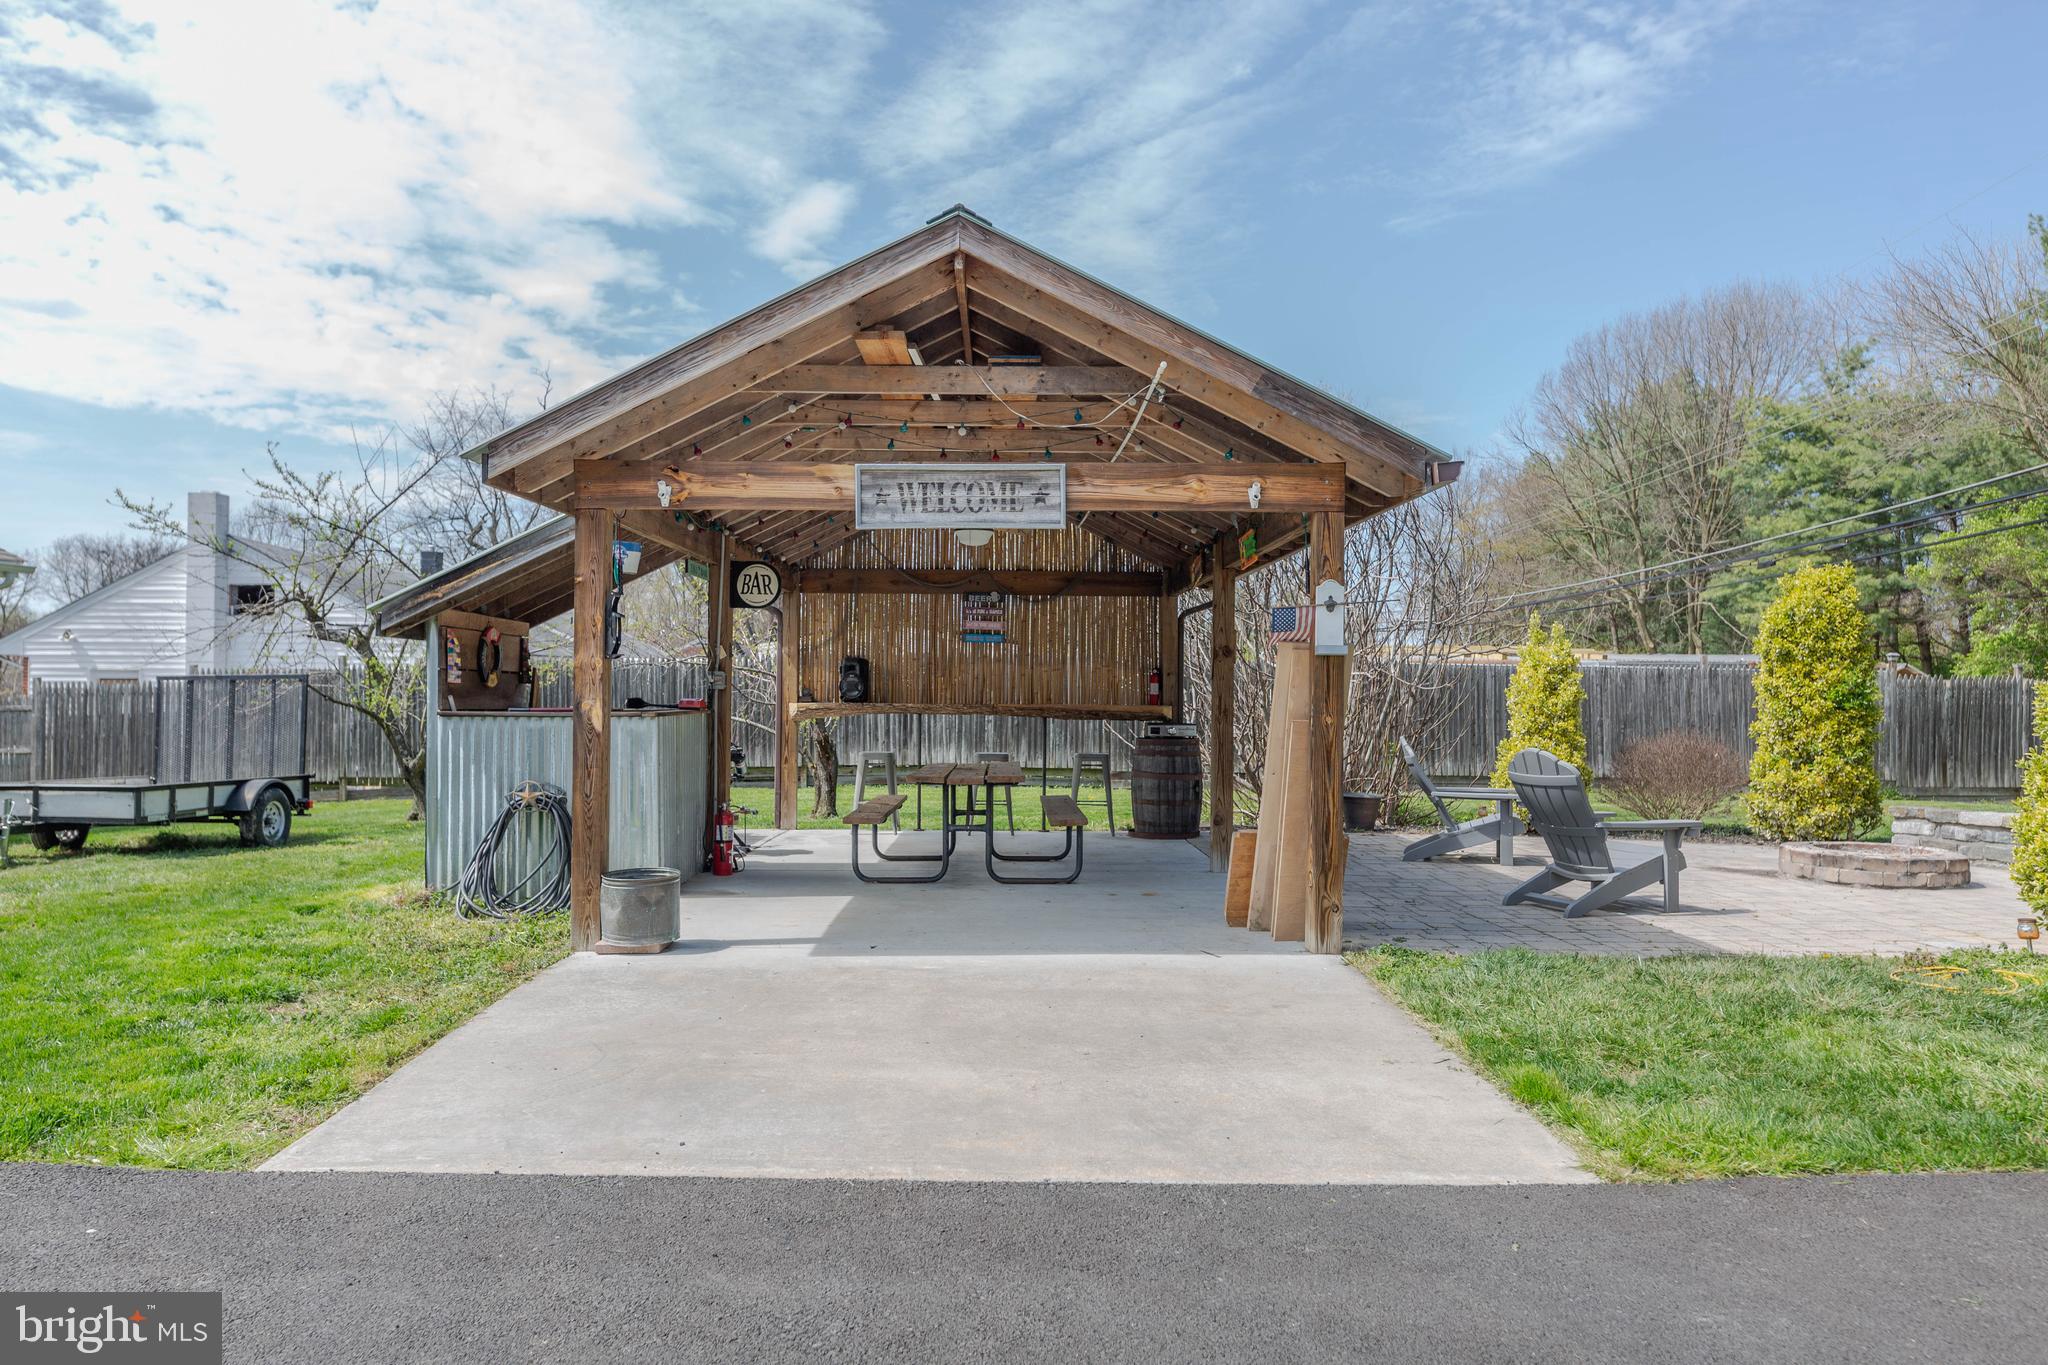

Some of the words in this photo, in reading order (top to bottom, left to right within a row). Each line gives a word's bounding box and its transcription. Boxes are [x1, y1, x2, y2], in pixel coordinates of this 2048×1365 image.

[896, 481, 1025, 514] WELCOME
[740, 571, 774, 595] BAR
[968, 594, 991, 602] BEER
